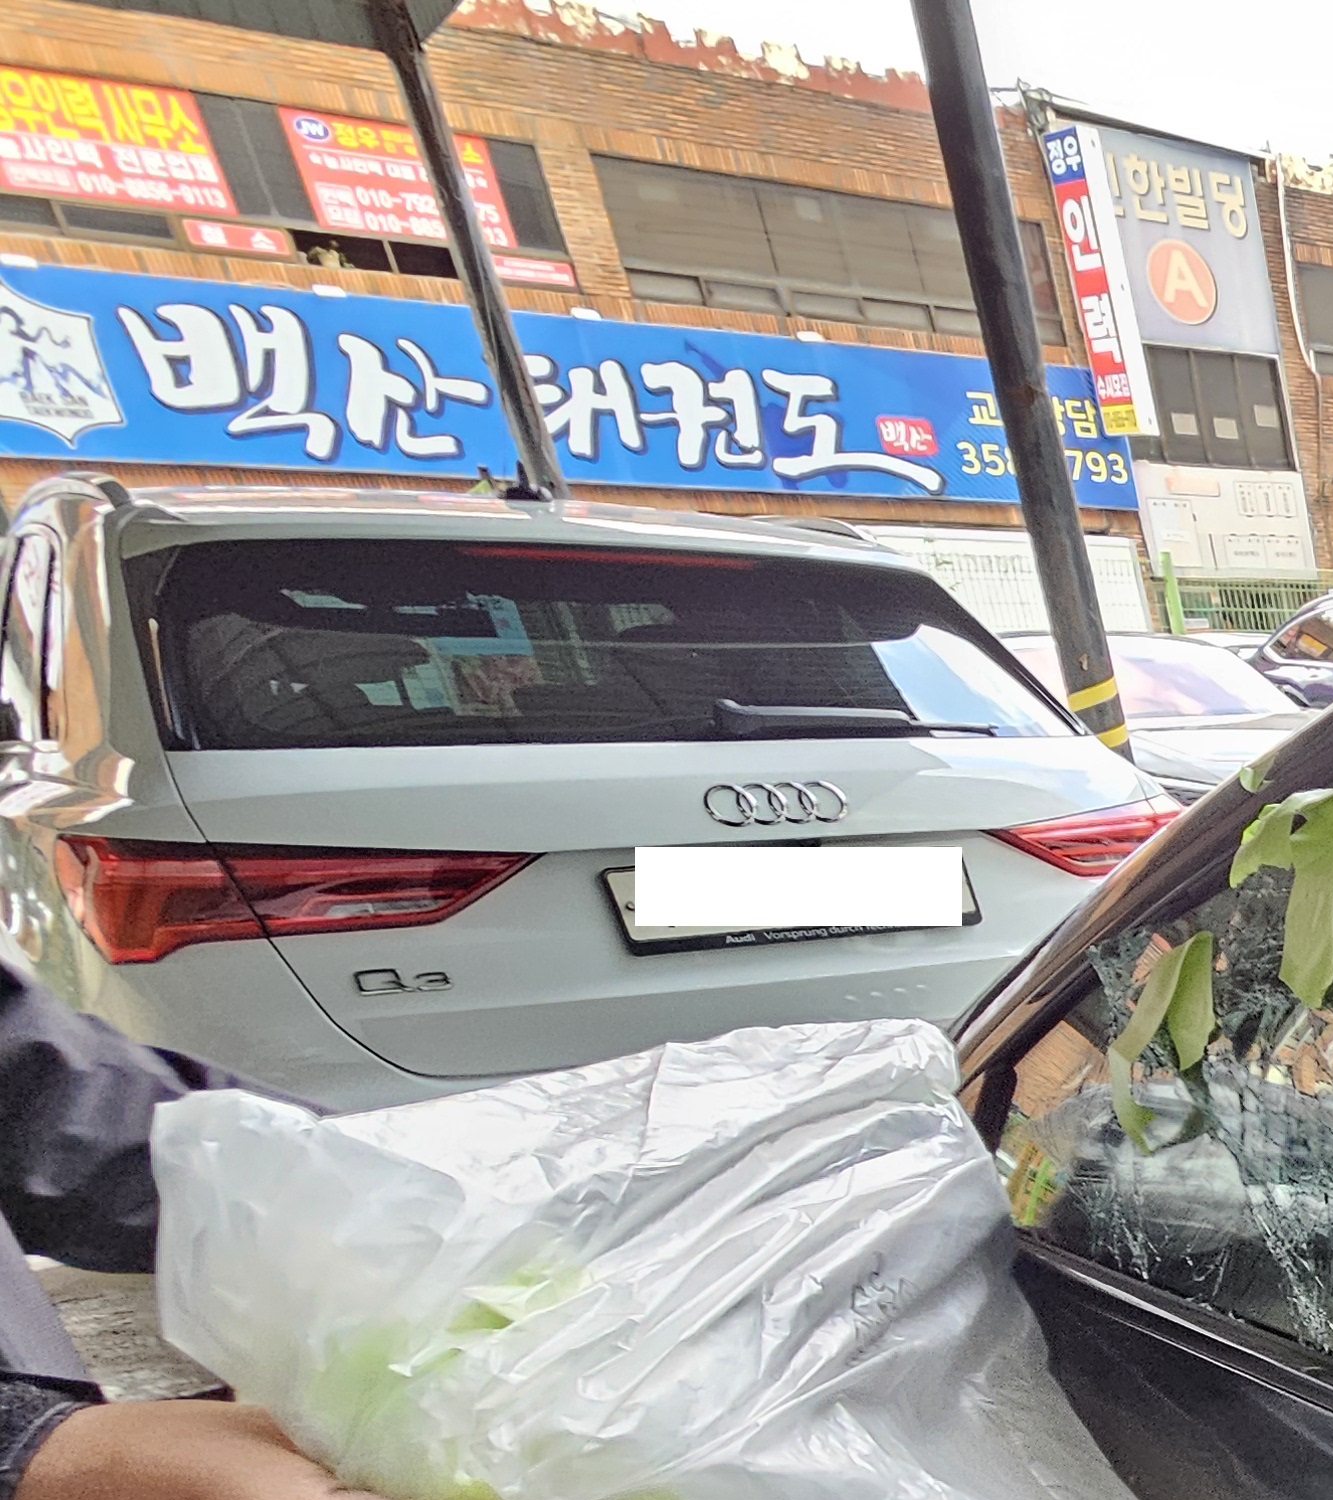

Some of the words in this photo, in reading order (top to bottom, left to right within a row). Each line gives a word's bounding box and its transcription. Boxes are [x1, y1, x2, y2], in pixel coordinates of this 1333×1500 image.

[1046, 134, 1083, 177] 정우
[1163, 248, 1209, 308] A
[879, 421, 933, 452] 백산
[725, 934, 757, 946] Audi
[353, 968, 453, 997] Q3
